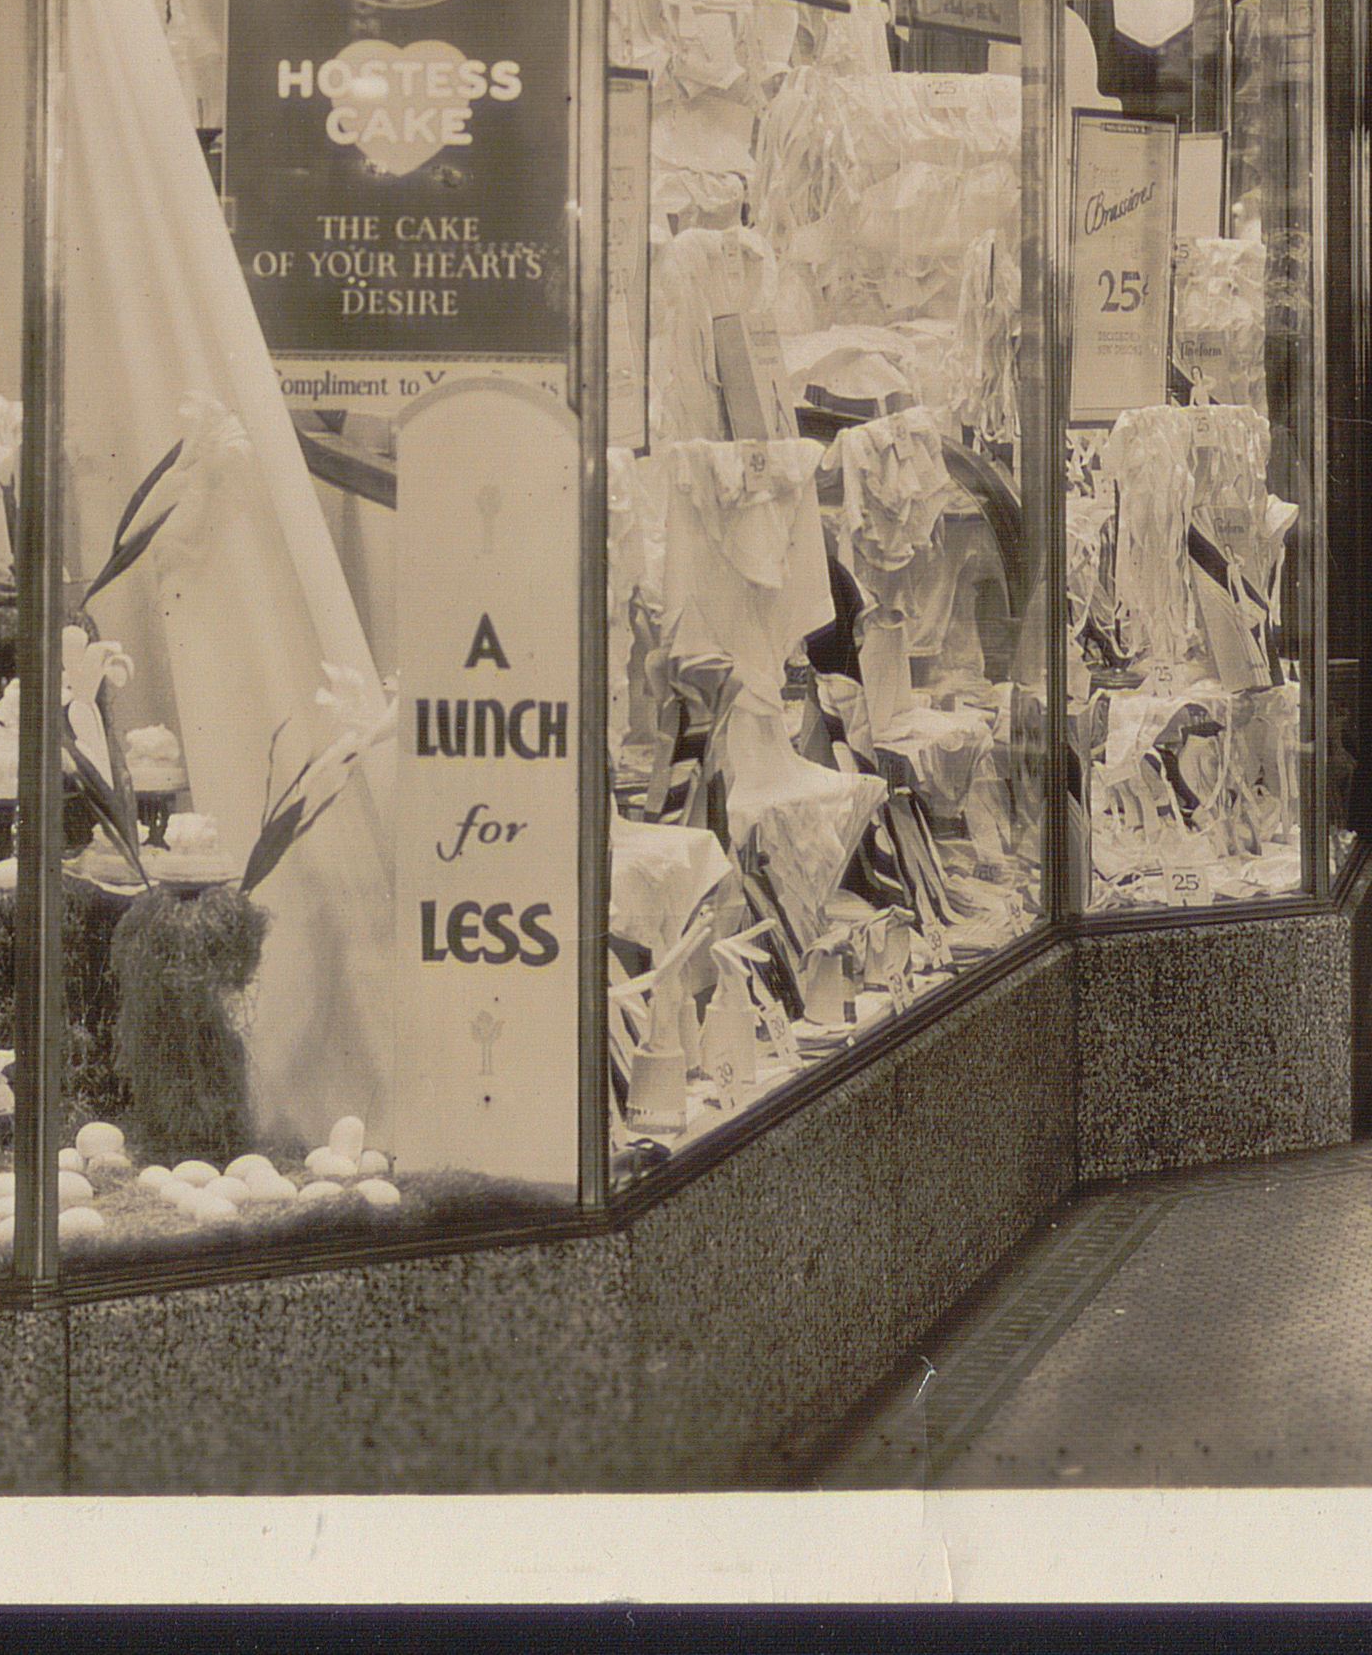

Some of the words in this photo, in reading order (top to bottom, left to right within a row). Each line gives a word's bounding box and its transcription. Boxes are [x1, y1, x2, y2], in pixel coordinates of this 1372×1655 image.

[277, 58, 524, 102] HOSTESS
[323, 104, 475, 147] CAKE
[316, 215, 381, 241] THE
[394, 216, 481, 242] CAKE
[252, 250, 294, 278] OF
[309, 251, 398, 279] YOUR
[412, 248, 543, 281] HEART'S
[340, 289, 460, 317] DESIRE
[1098, 269, 1151, 313] 25¢
[274, 369, 389, 401] ompliment
[399, 378, 421, 397] to
[465, 612, 510, 669] A
[415, 698, 569, 760] LUNCH
[436, 803, 528, 863] for
[421, 900, 561, 967] LESS
